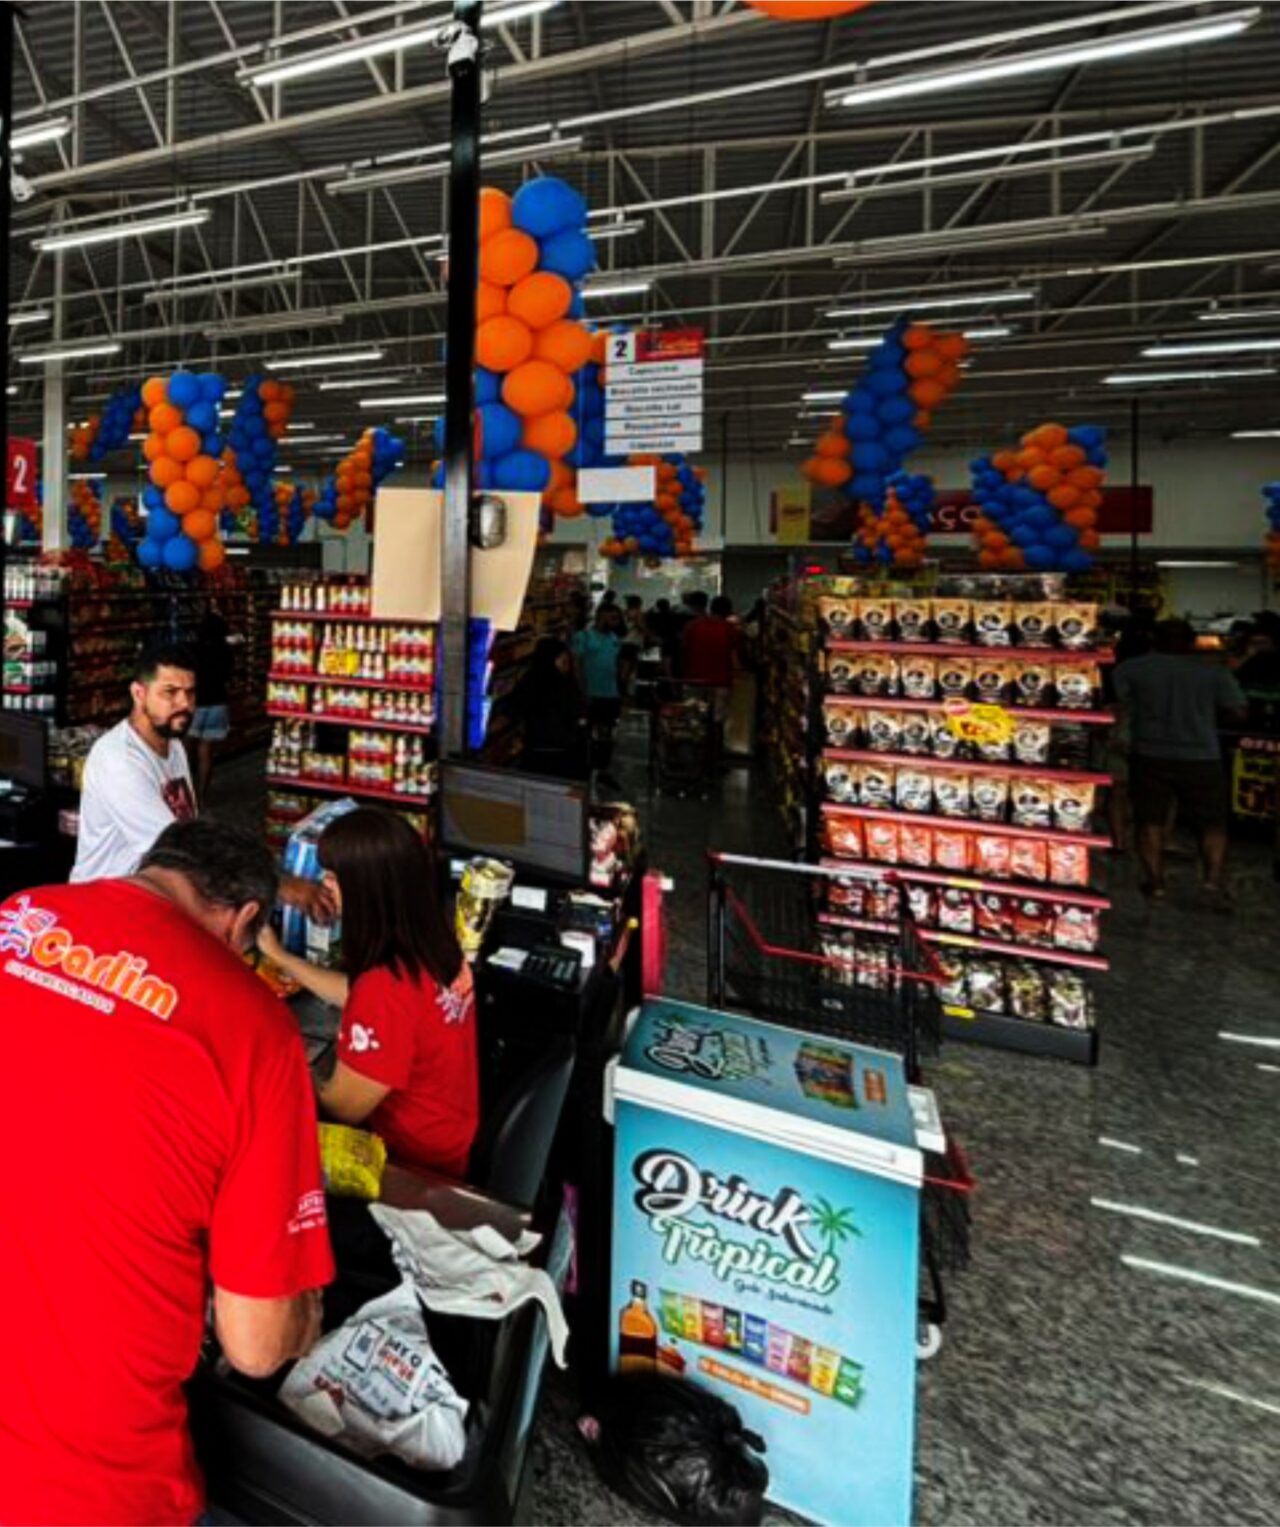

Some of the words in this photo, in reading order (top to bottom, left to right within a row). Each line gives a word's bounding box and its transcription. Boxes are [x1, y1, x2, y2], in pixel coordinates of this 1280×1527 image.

[614, 340, 627, 358] 2
[13, 454, 28, 493] 2
[32, 927, 178, 1020] Carlim
[632, 1148, 818, 1262] Drink
[650, 1213, 840, 1296] Tropical
